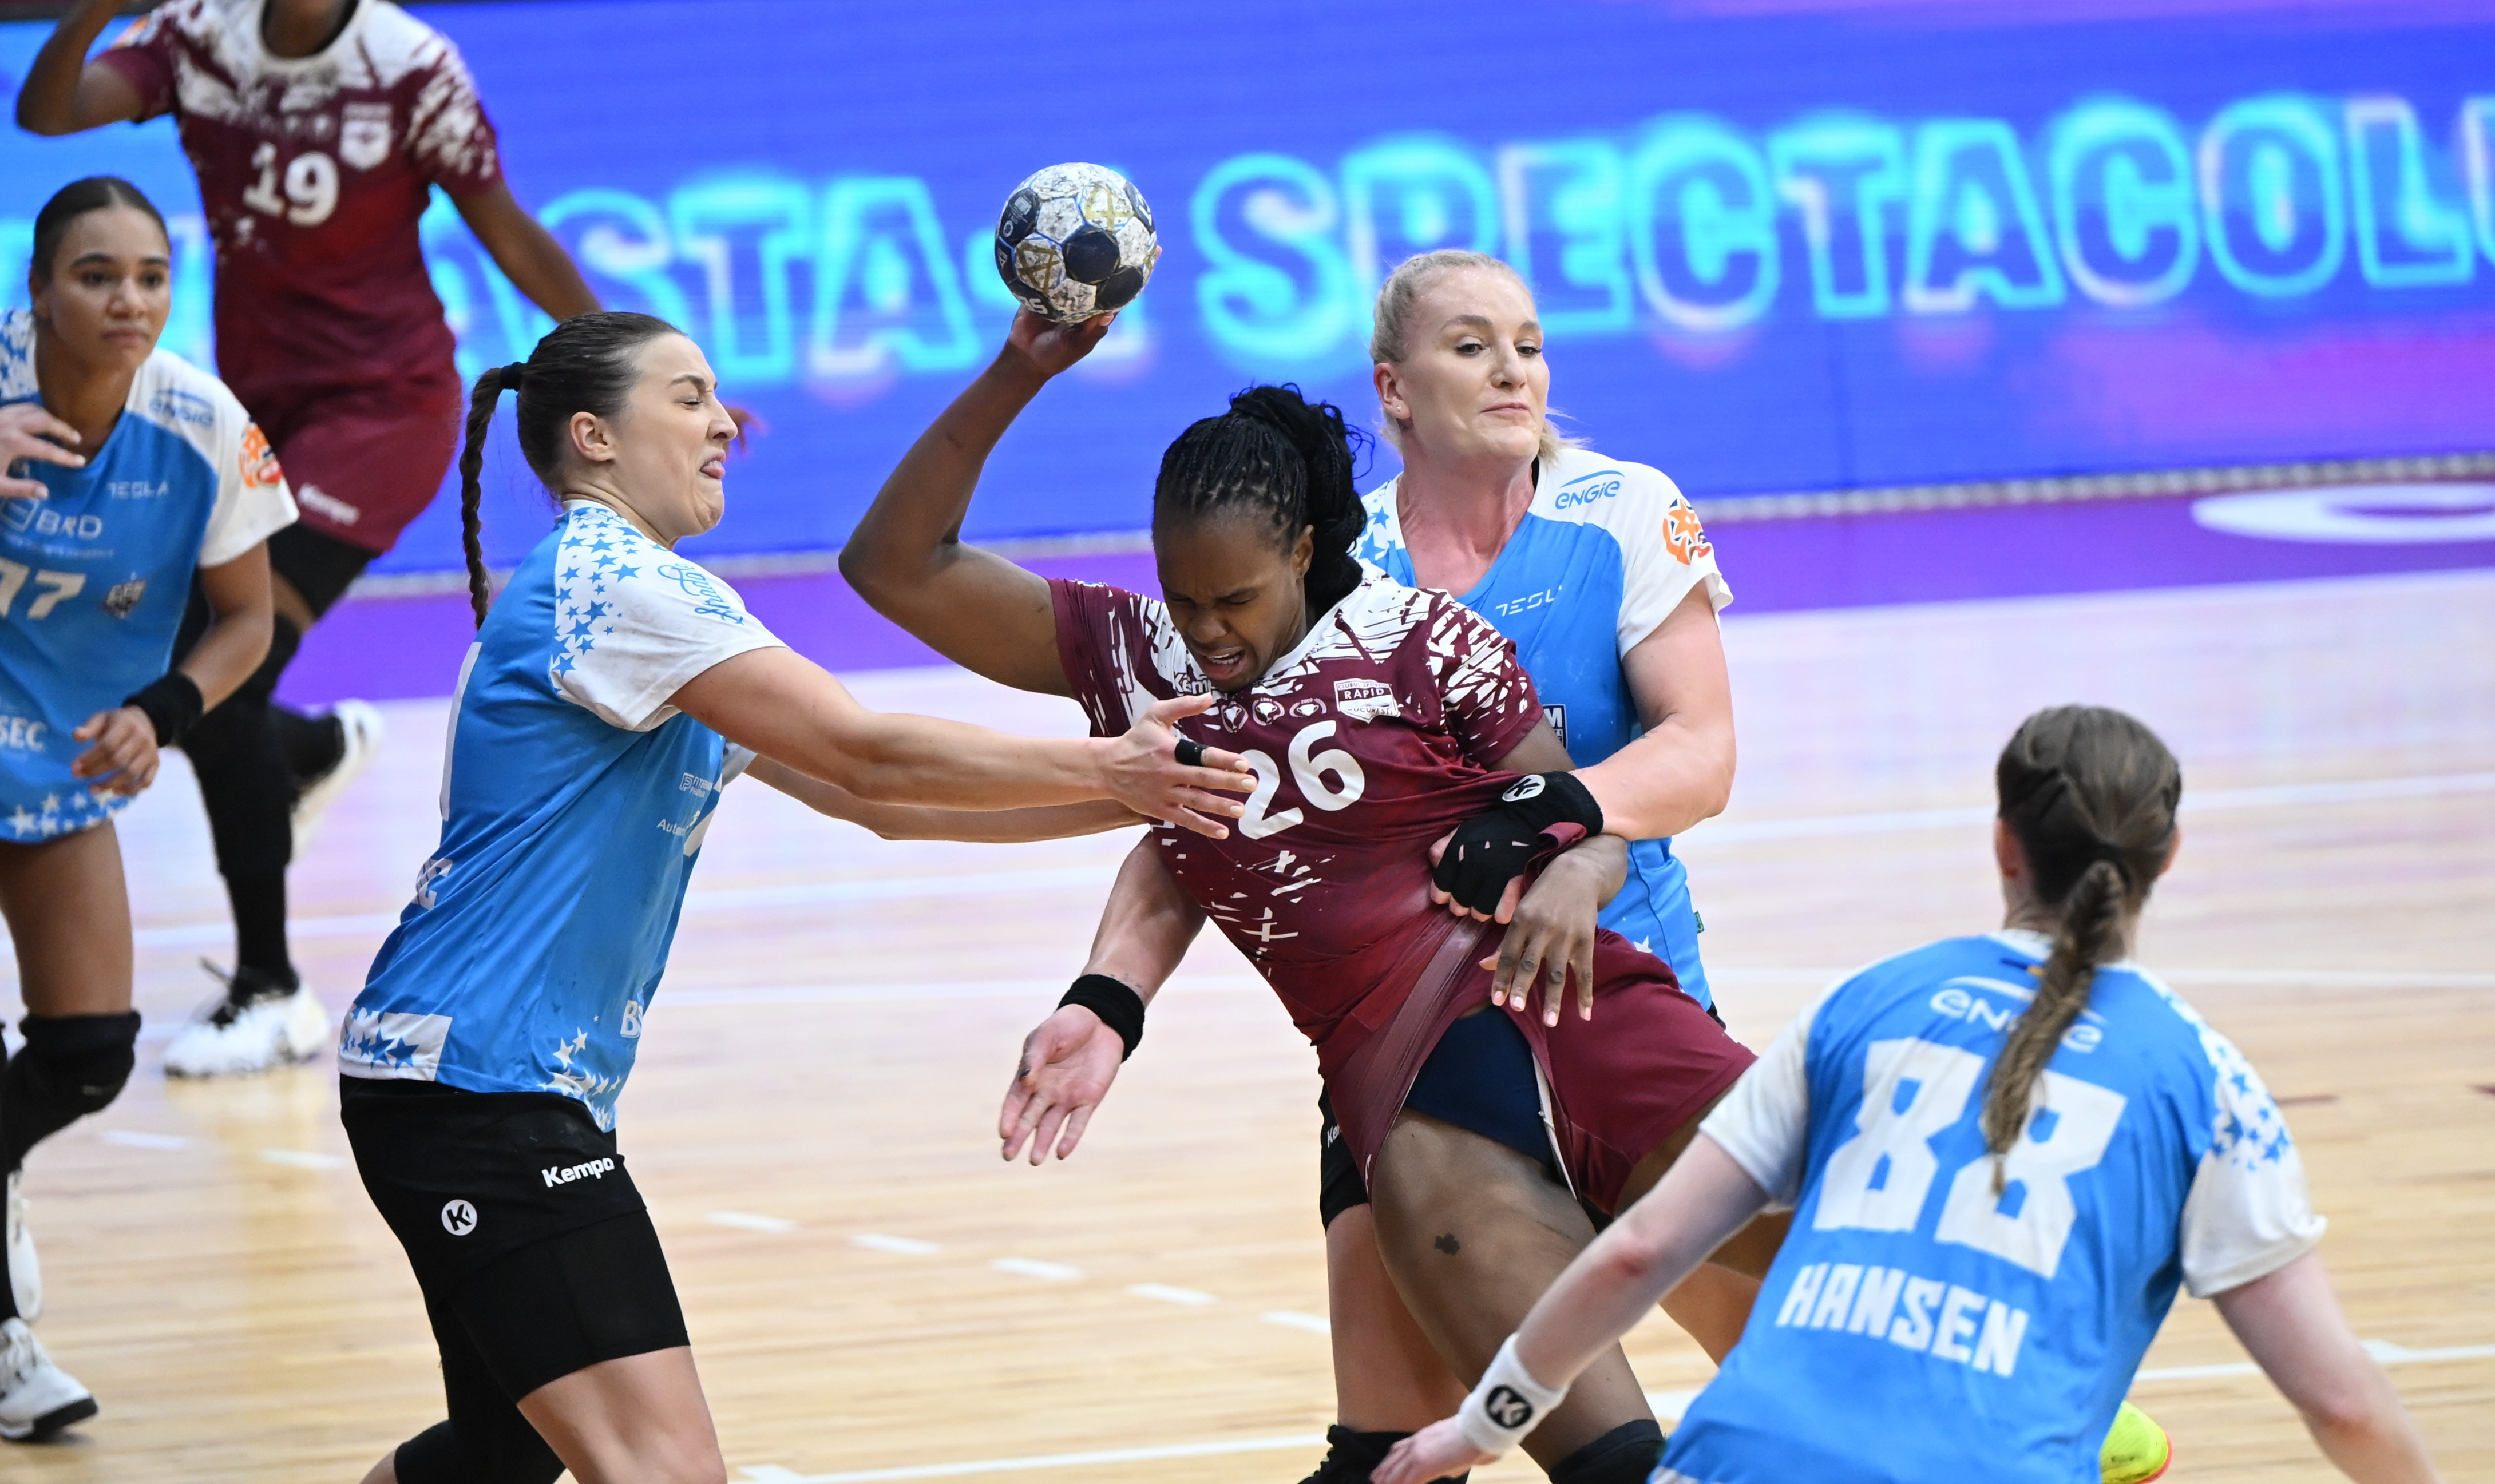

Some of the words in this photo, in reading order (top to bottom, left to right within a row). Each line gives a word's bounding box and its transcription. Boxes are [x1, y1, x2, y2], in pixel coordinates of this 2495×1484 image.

[242, 141, 340, 227] 19
[1495, 584, 1563, 617] TESL
[1344, 688, 1384, 700] RAPID
[1238, 720, 1365, 840] 26
[541, 1157, 615, 1188] Kempa
[1812, 1037, 2129, 1280] 88
[1775, 1262, 2030, 1378] HANSEN
